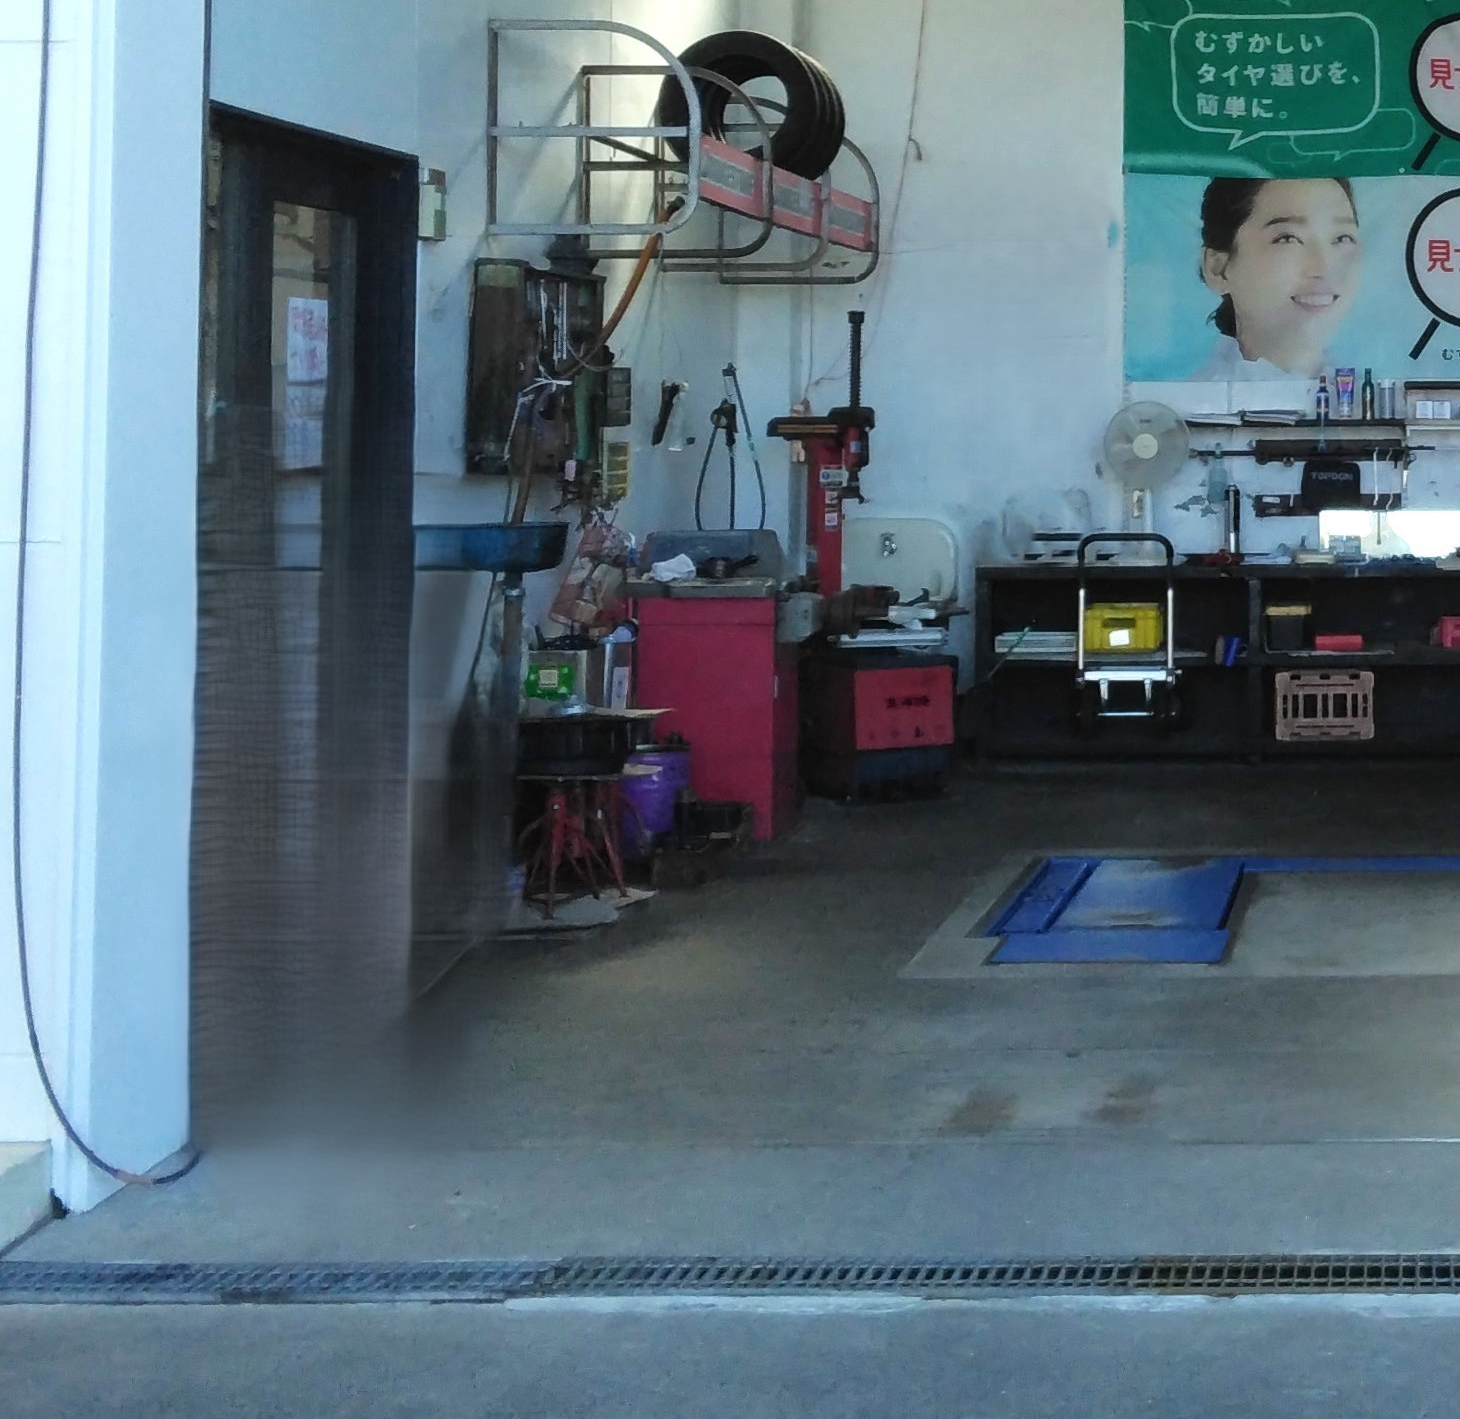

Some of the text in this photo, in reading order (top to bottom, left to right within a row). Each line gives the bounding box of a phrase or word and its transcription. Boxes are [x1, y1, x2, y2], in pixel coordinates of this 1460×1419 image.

[1195, 30, 1324, 54] むずかしい
[1196, 61, 1360, 87] タイヤ選びを、
[1196, 92, 1288, 119] 簡単に。
[1310, 470, 1354, 482] TOPDON
